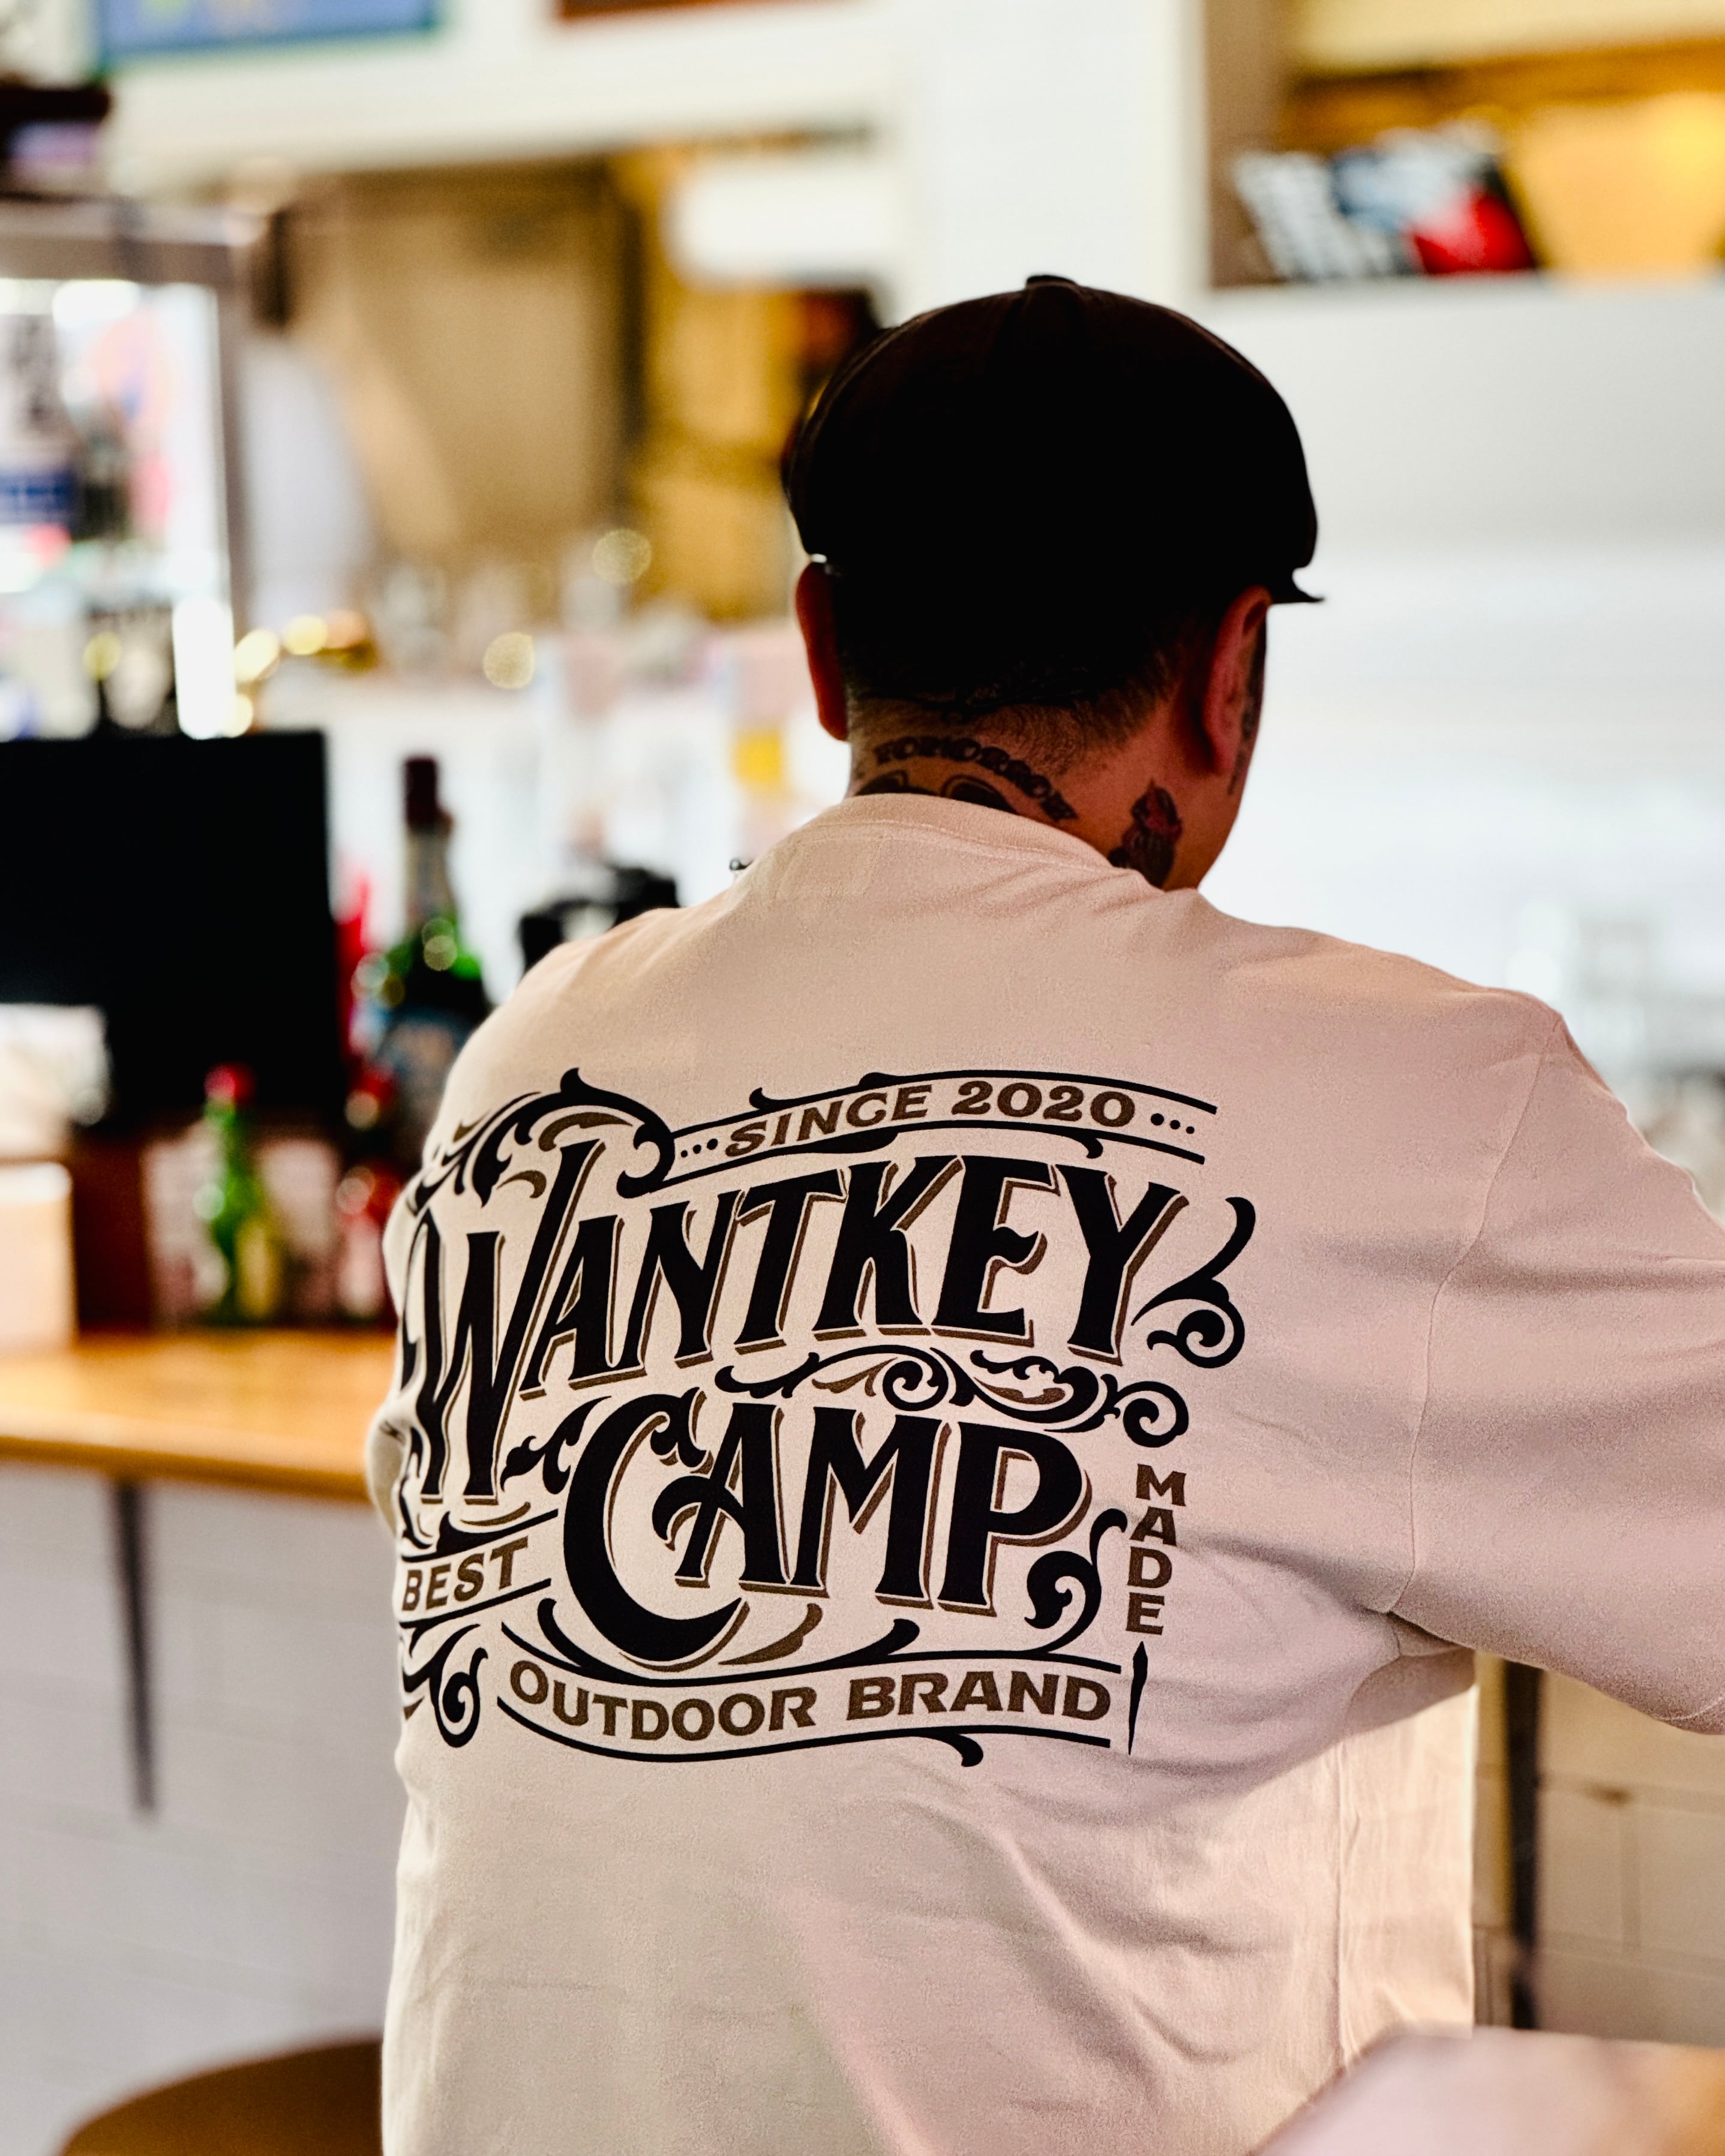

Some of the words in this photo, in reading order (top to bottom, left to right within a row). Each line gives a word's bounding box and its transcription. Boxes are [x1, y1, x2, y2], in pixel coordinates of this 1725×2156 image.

[724, 1085, 932, 1158] SINCE
[951, 1080, 1136, 1128] 2020
[401, 1137, 1190, 1505] WANTKEY
[401, 1536, 529, 1612] BEST
[563, 1386, 1093, 1672] CAMP
[1125, 1463, 1186, 1635] MADE
[509, 1660, 817, 1741] OUTDOOR
[846, 1670, 1111, 1720] BRAND
